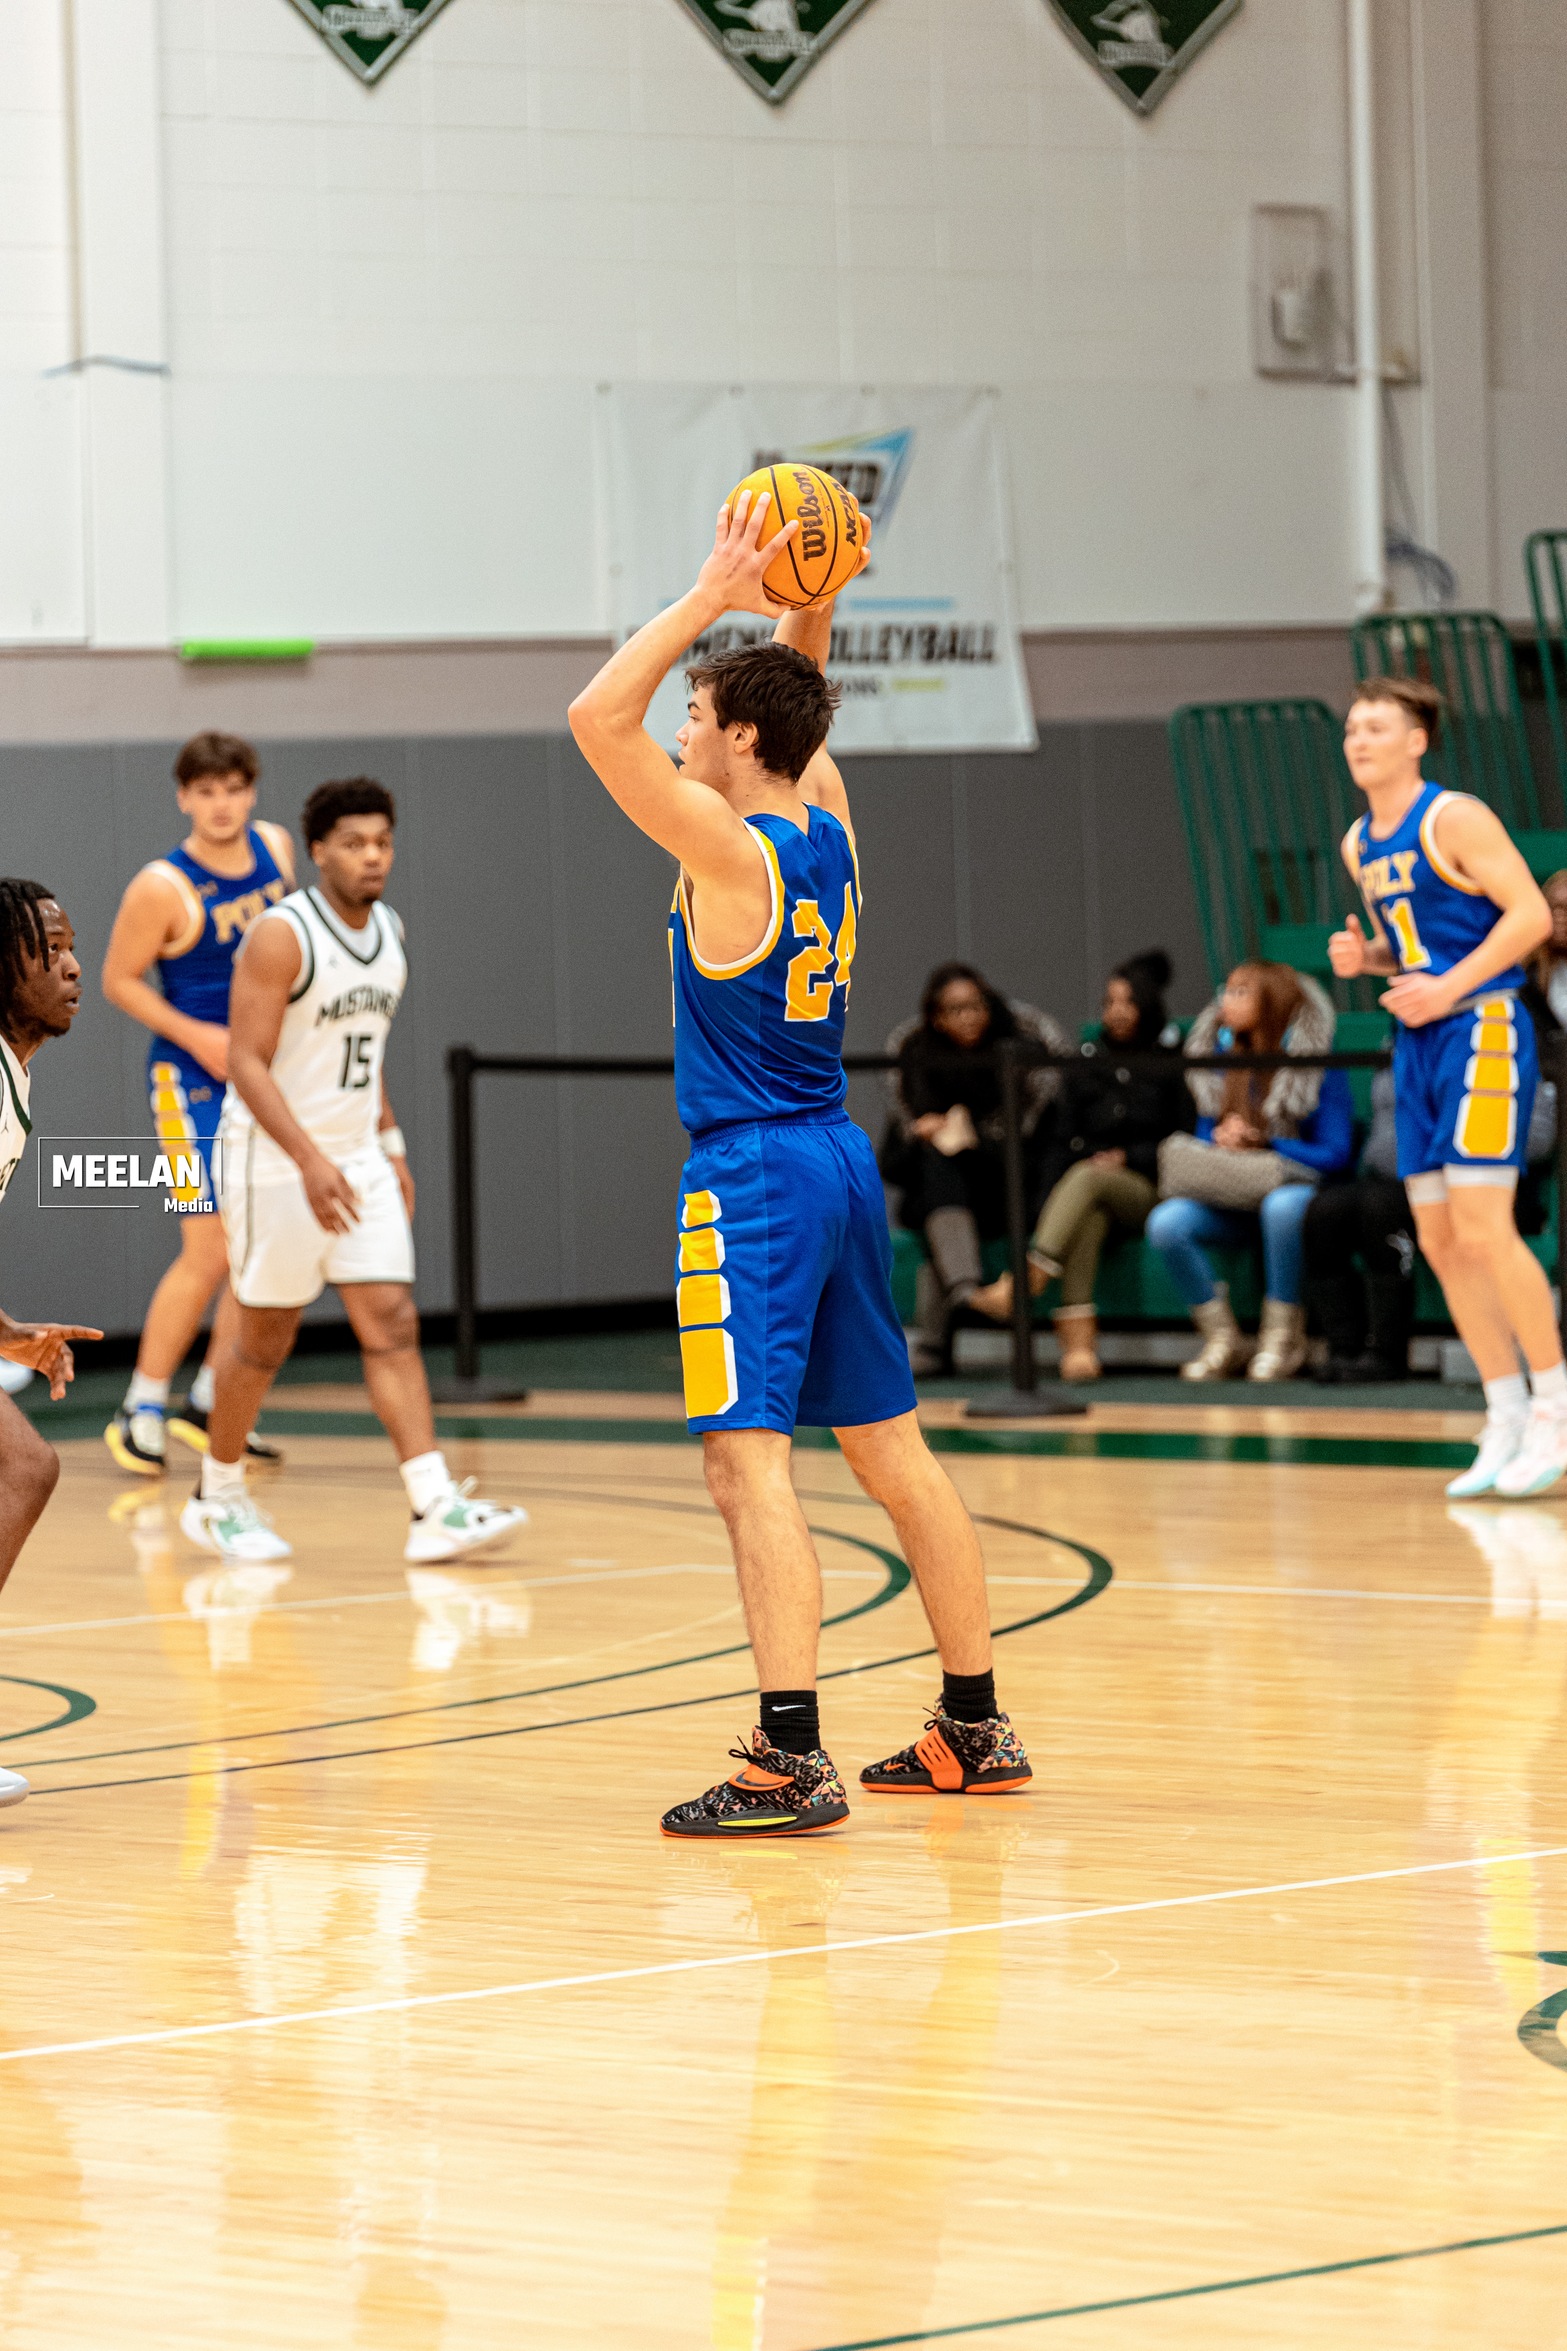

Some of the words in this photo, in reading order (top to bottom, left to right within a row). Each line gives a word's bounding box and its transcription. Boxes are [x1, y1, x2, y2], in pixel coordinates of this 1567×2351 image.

[792, 471, 827, 561] Wilson
[785, 880, 857, 1021] 24
[340, 1032, 373, 1089] 15
